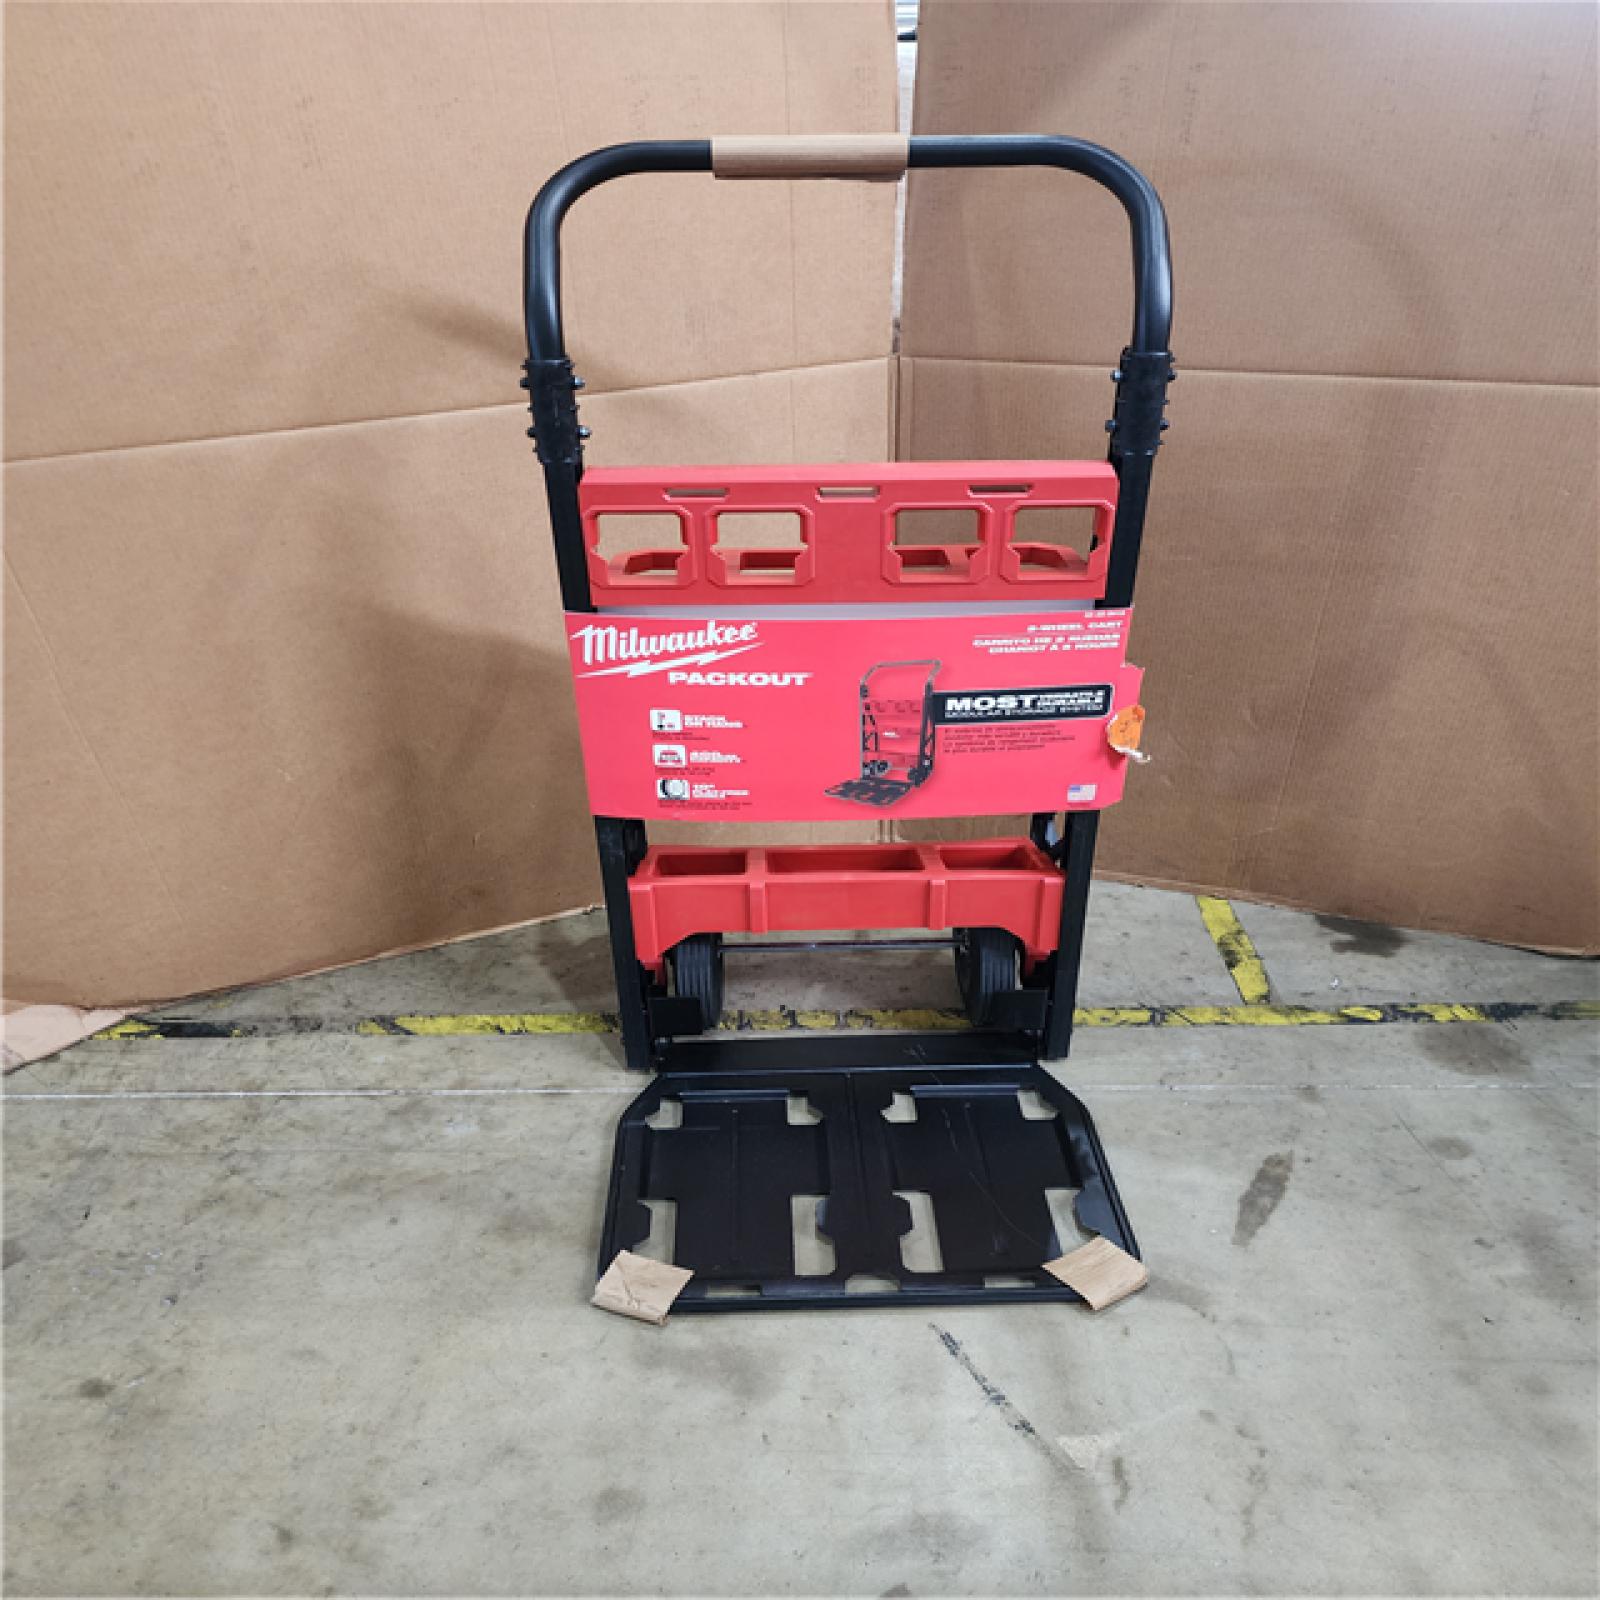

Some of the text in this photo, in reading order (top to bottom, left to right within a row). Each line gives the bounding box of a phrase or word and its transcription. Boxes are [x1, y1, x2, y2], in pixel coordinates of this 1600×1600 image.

[570, 620, 757, 665] Milwaukee
[667, 671, 812, 686] PACKOUT
[946, 694, 1039, 712] MOST
